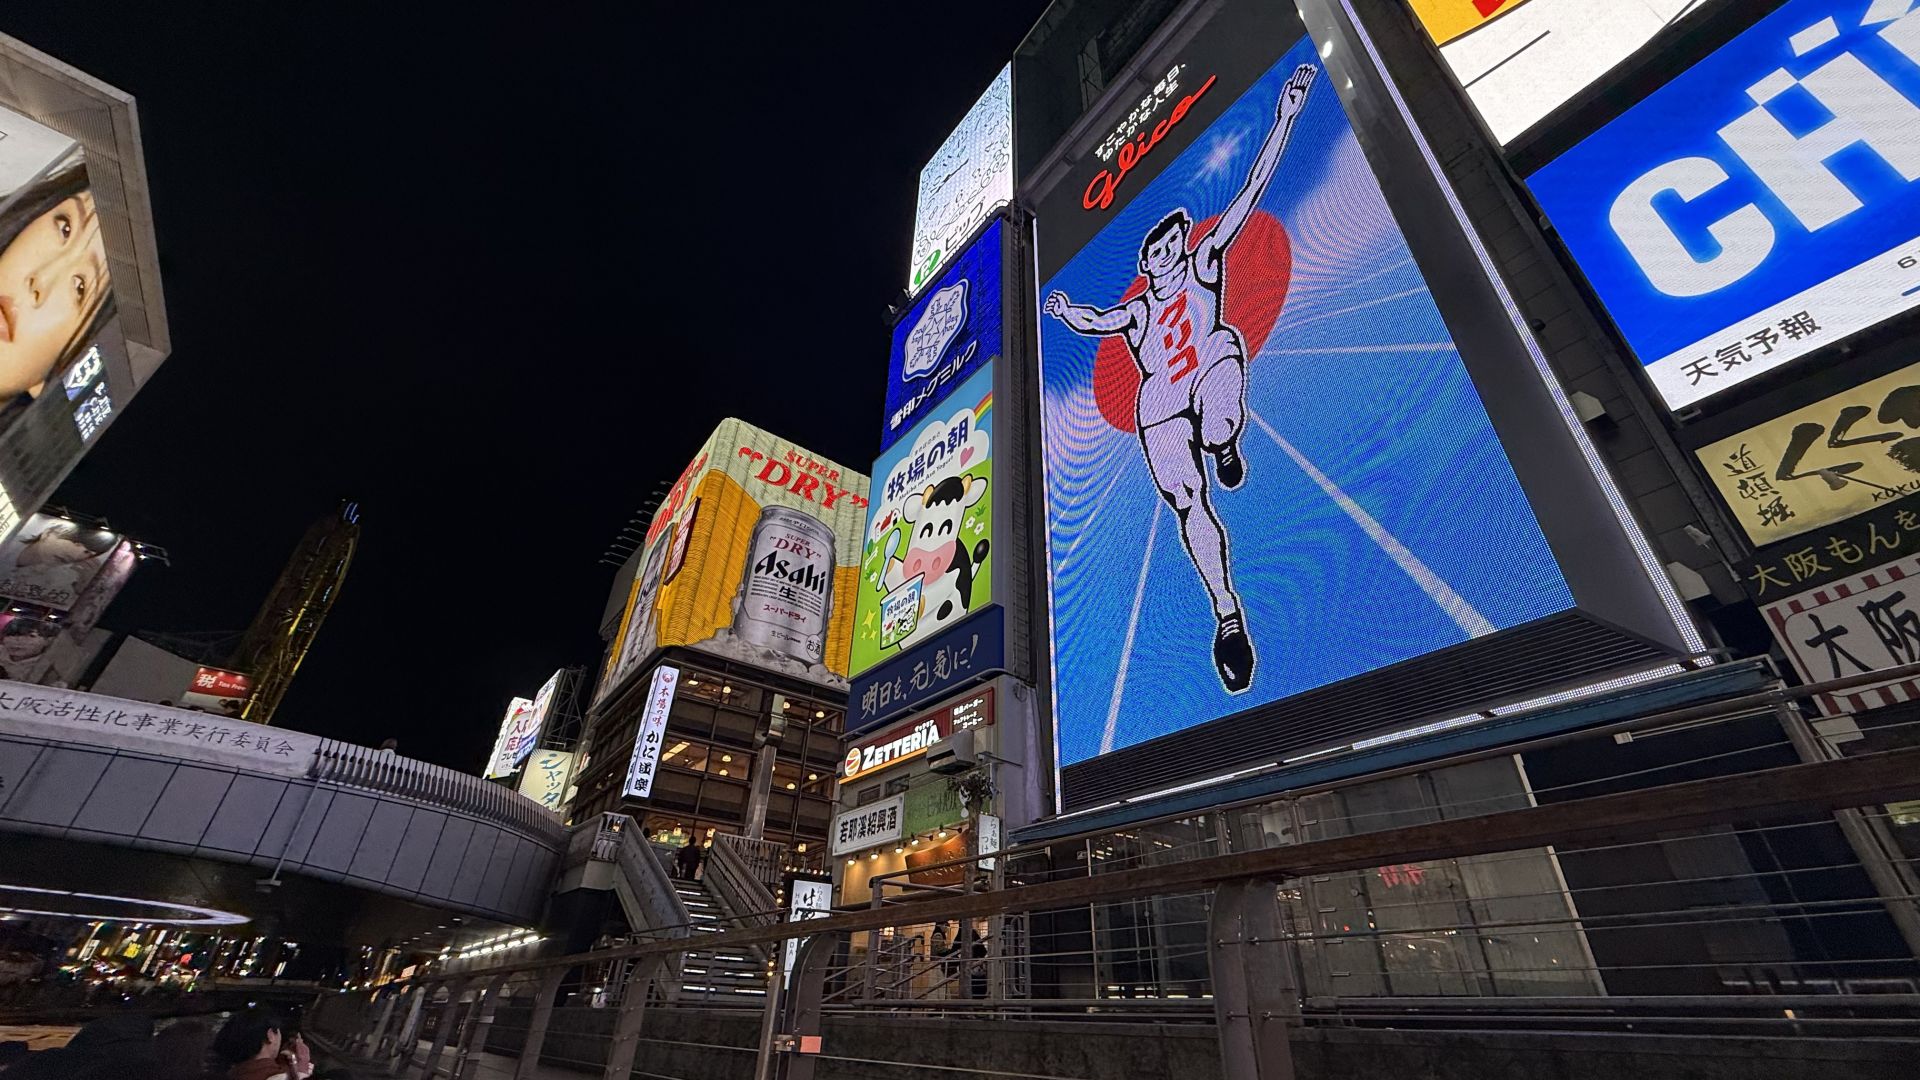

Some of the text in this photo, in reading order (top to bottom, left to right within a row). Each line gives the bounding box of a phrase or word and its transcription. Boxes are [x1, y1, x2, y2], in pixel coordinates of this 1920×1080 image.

[1102, 83, 1180, 162] ゆたかな人生
[1158, 291, 1199, 385] グリコ
[1681, 310, 1822, 386] 天気予報
[890, 340, 977, 431] 雪印メグミルク
[784, 449, 841, 482] SUPER
[888, 416, 969, 502] 牧場の朝
[1723, 443, 1795, 527] 道頓堀
[785, 533, 811, 547] SUPER
[754, 550, 827, 596] Asahi
[779, 585, 798, 602] 生
[763, 604, 808, 624] スーパードライ
[0, 692, 296, 757] 大阪活性化事業実行委員会
[652, 686, 670, 727] 本場の味
[633, 730, 660, 792] かに道楽
[862, 724, 941, 771] ZETTERIA
